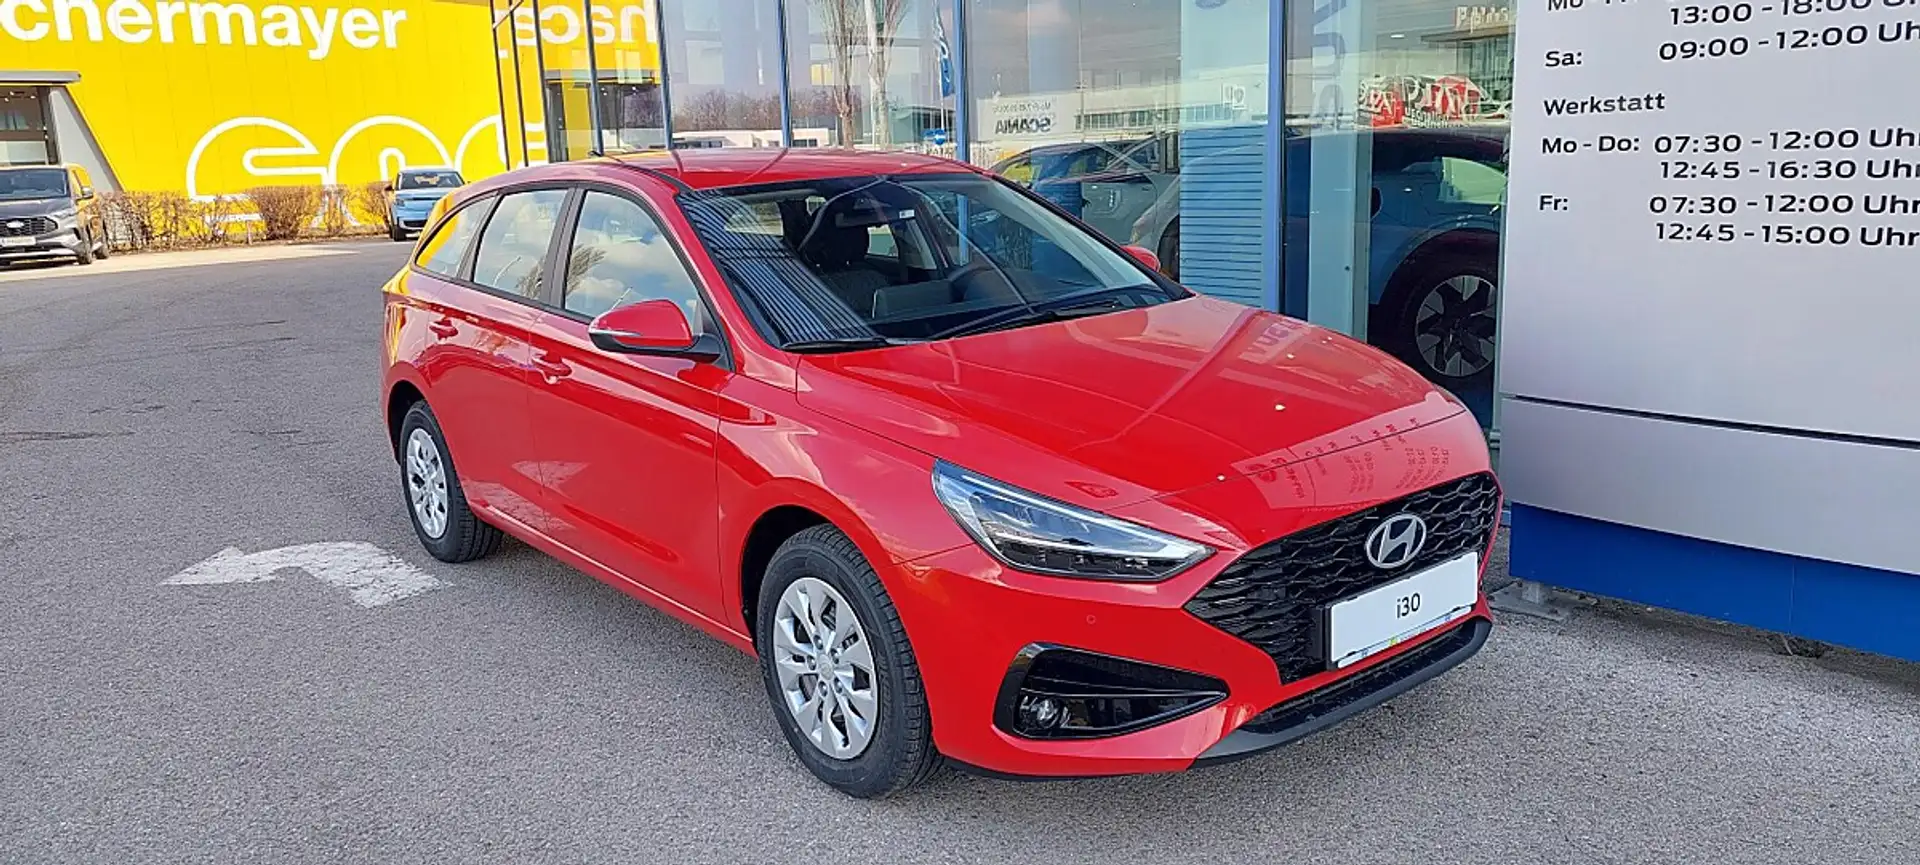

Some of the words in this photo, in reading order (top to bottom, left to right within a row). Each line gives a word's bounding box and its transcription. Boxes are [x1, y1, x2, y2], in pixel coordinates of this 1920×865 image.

[1670, 3, 1752, 25] 13:00
[1545, 51, 1582, 67] Sa:
[1659, 37, 1749, 60] 09:00
[1776, 25, 1868, 49] 12:00
[1544, 93, 1665, 116] Werkstatt
[1654, 134, 1742, 153] 07:30
[1769, 129, 1859, 150] 12:00
[1661, 161, 1740, 179] 12:45
[1767, 160, 1857, 179] 16:30
[1539, 195, 1568, 211] Fr:
[1650, 196, 1737, 214] 07:30
[1765, 195, 1854, 213] 12:00
[1863, 195, 1920, 214] Uhr
[1656, 223, 1735, 242] 12:45
[1762, 225, 1850, 244] 15:00
[1860, 227, 1920, 246] Uhr
[1396, 593, 1421, 619] i30
